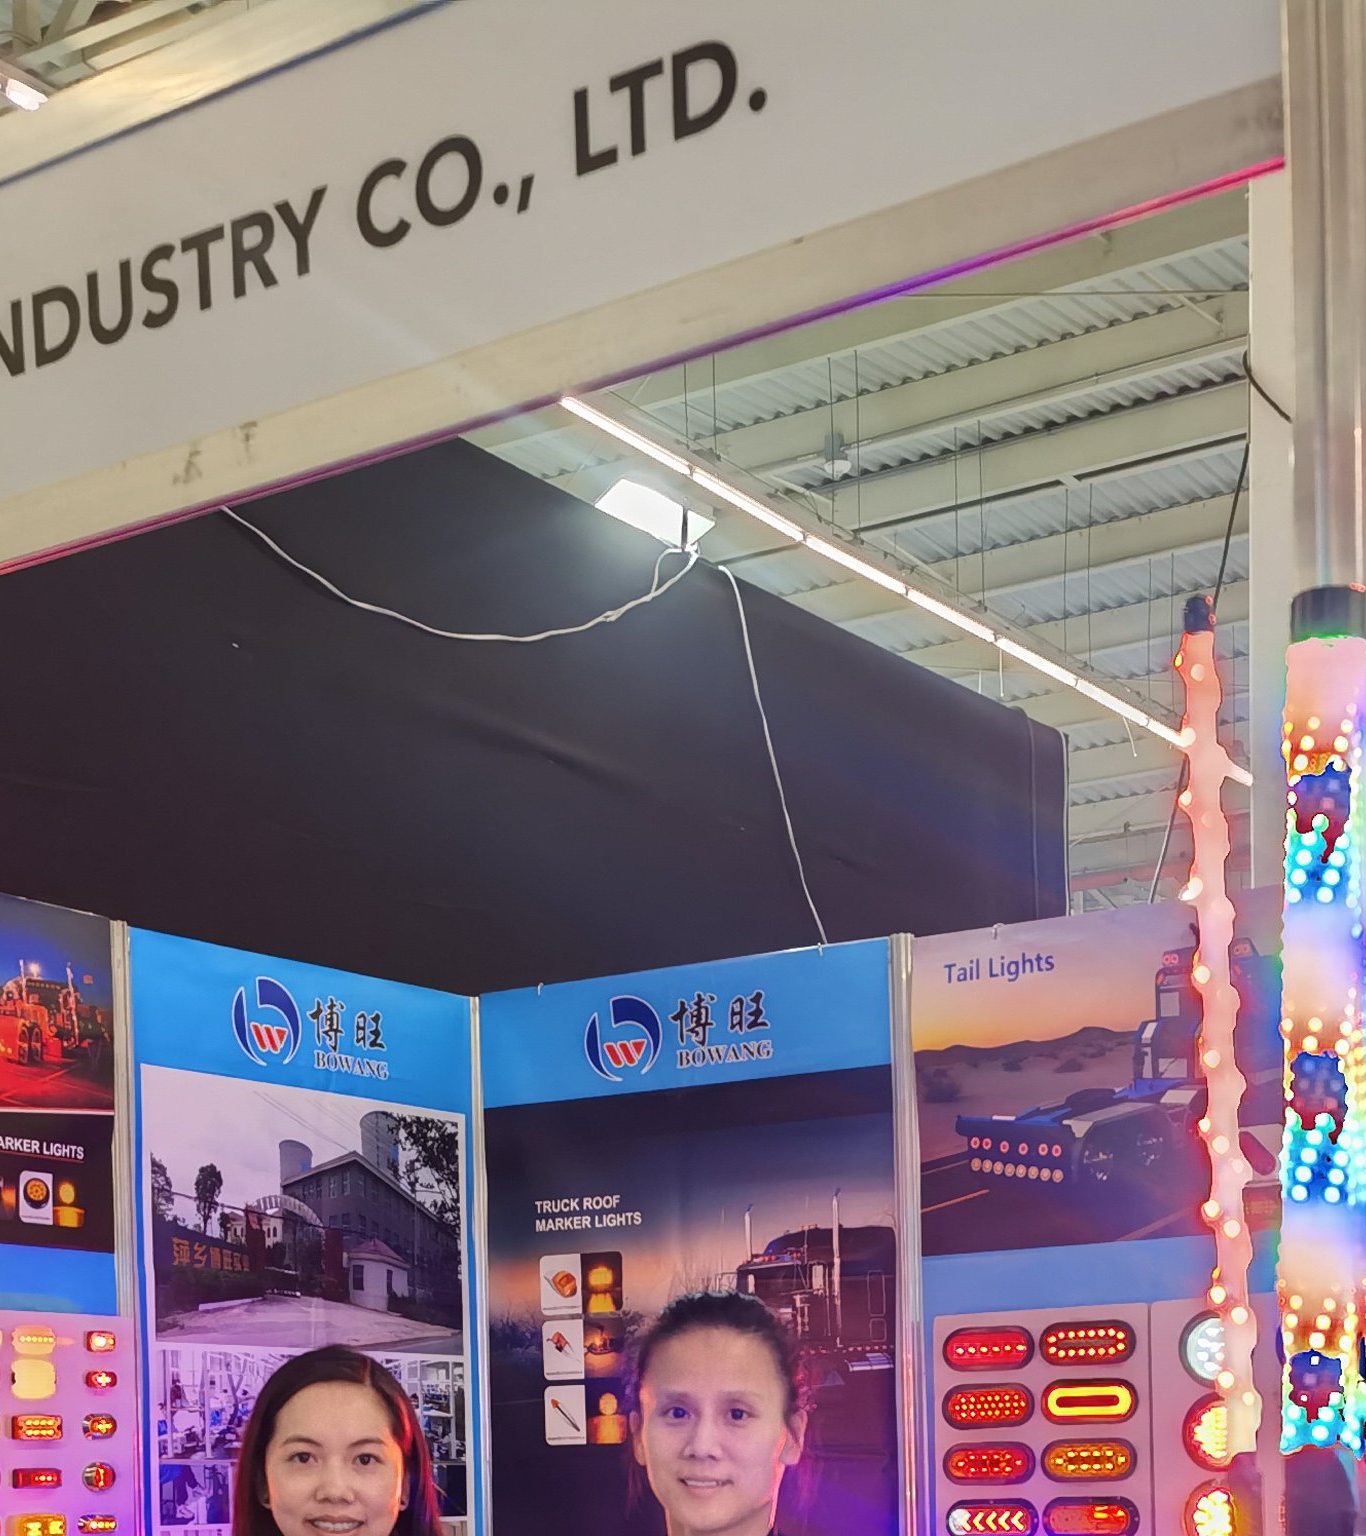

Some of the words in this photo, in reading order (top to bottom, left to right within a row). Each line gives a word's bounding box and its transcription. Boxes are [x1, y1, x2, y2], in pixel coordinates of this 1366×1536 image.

[353, 134, 537, 251] CO.,
[571, 39, 770, 178] LTD.
[943, 959, 981, 984] Tail
[988, 952, 1055, 981] Lights
[306, 994, 390, 1052] 博旺
[668, 989, 771, 1046] 博旺
[313, 1050, 389, 1081] BOWANG
[676, 1039, 773, 1069] BOWANG
[43, 1141, 85, 1160] LIGHTS
[535, 1199, 580, 1215] TRUCK
[582, 1195, 621, 1210] ROOF
[535, 1216, 590, 1233] MARKER
[593, 1211, 642, 1228] LIGHTS
